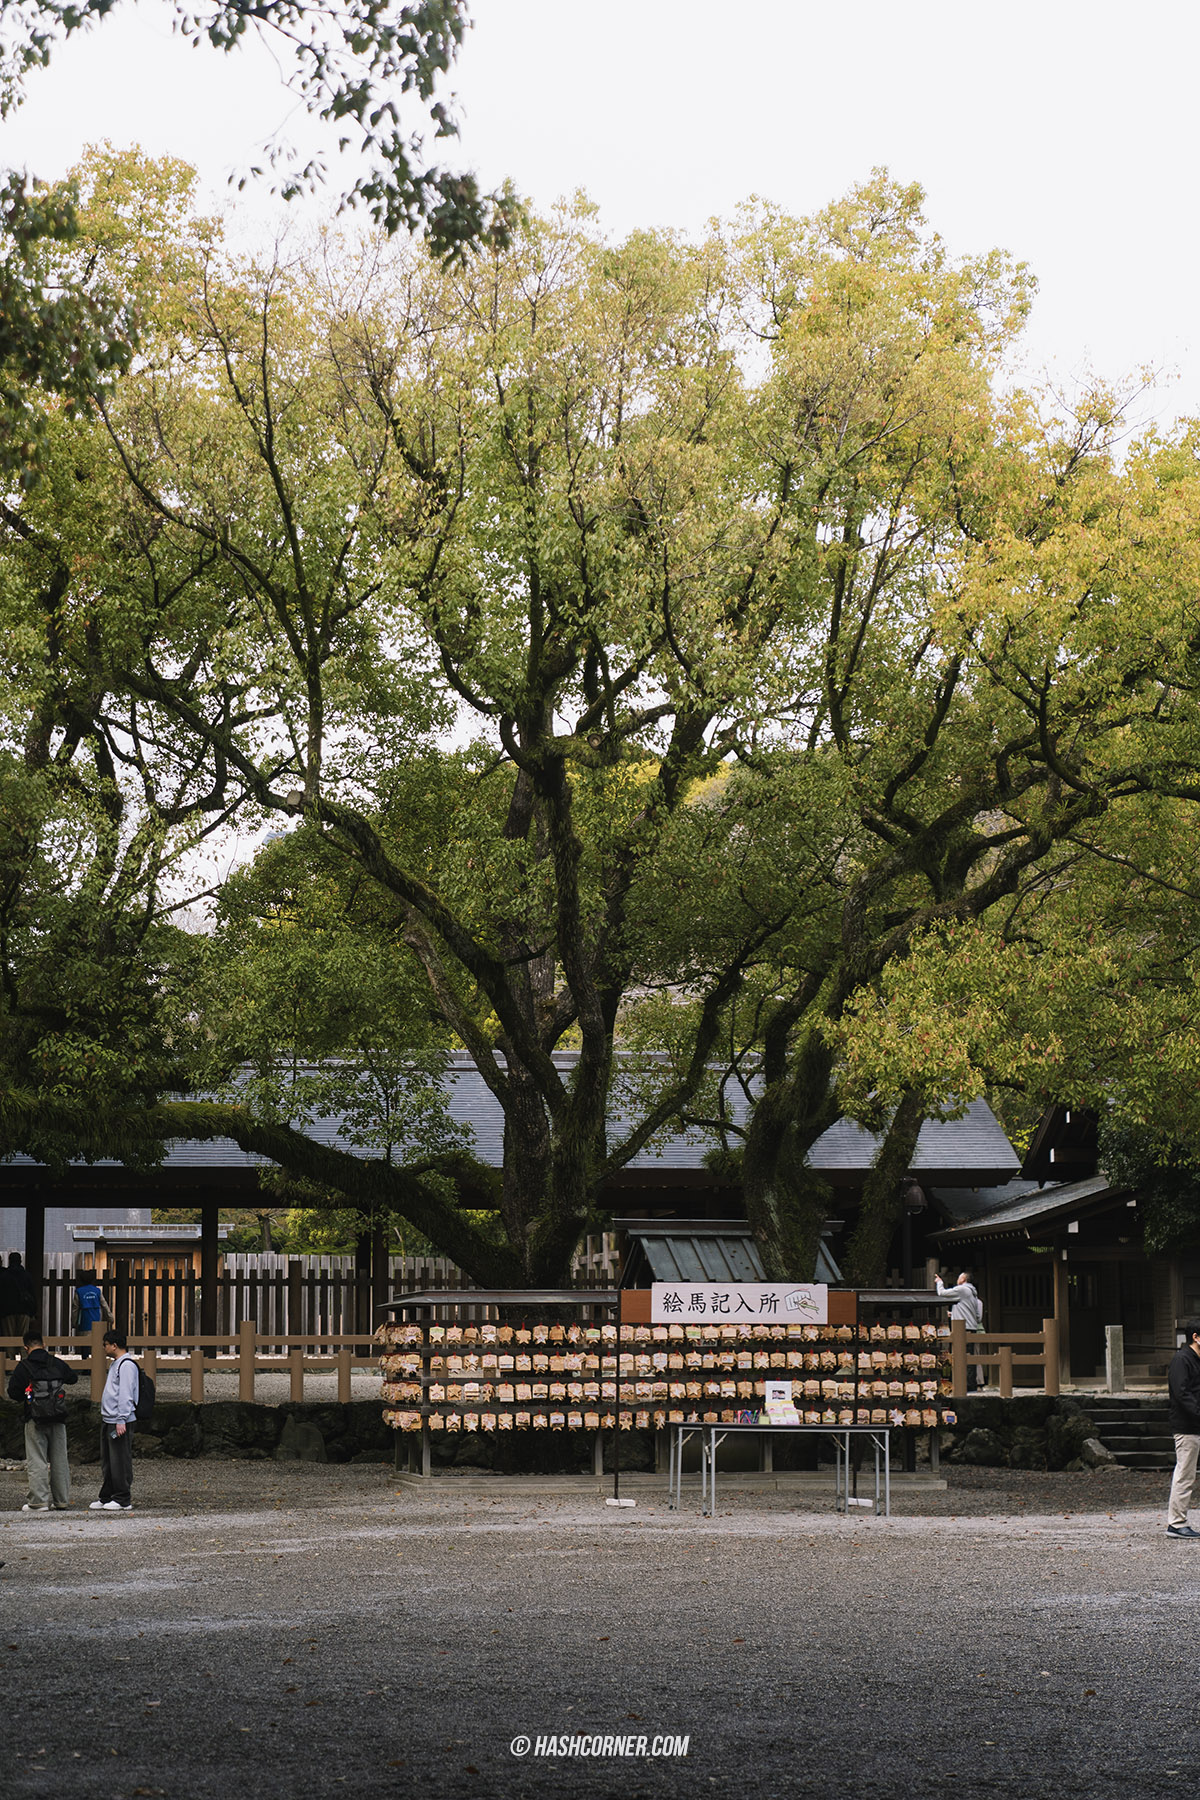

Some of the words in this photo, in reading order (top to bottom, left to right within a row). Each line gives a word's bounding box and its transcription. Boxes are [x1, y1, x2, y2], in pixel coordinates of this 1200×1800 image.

[662, 1291, 780, 1314] 絵馬記入所
